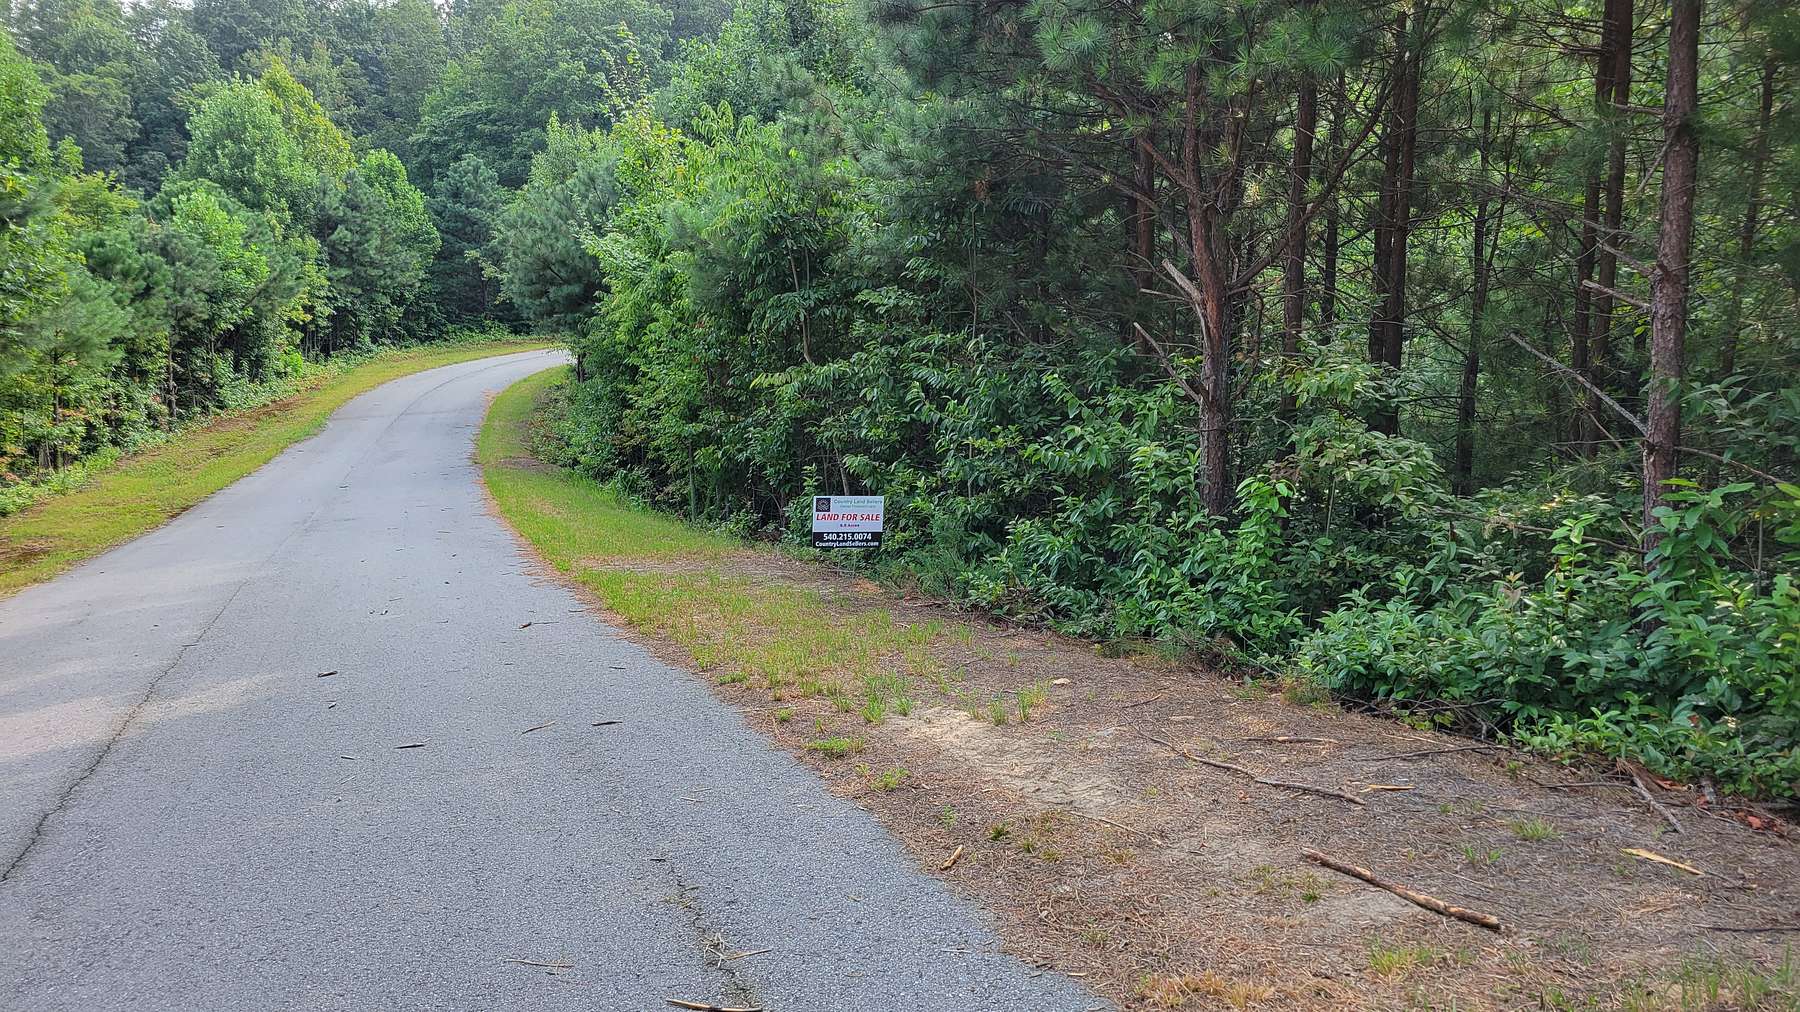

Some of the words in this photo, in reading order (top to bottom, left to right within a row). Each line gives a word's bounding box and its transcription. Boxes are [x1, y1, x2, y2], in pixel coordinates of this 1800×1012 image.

[816, 513, 839, 521] LAND
[841, 513, 857, 521] FOR
[860, 513, 880, 521] SALE
